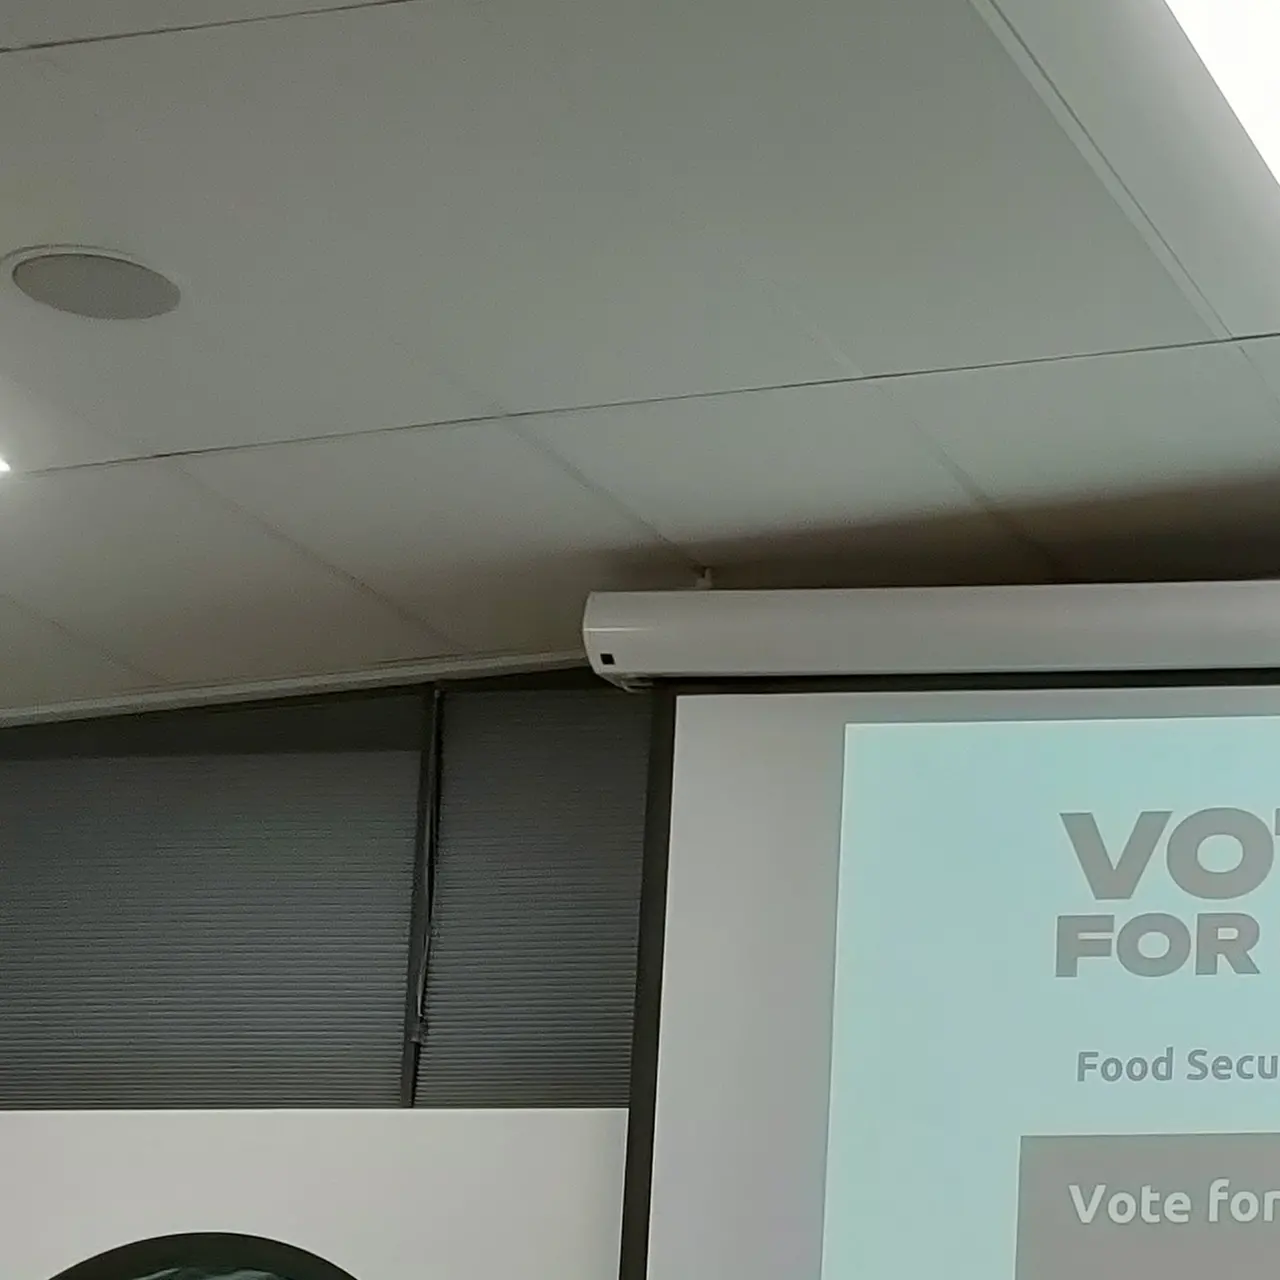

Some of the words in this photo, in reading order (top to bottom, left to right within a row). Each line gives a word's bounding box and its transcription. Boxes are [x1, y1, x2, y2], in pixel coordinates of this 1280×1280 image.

[1055, 911, 1262, 978] FOR
[1077, 1046, 1174, 1082] Food
[1068, 1184, 1192, 1224] Vote
